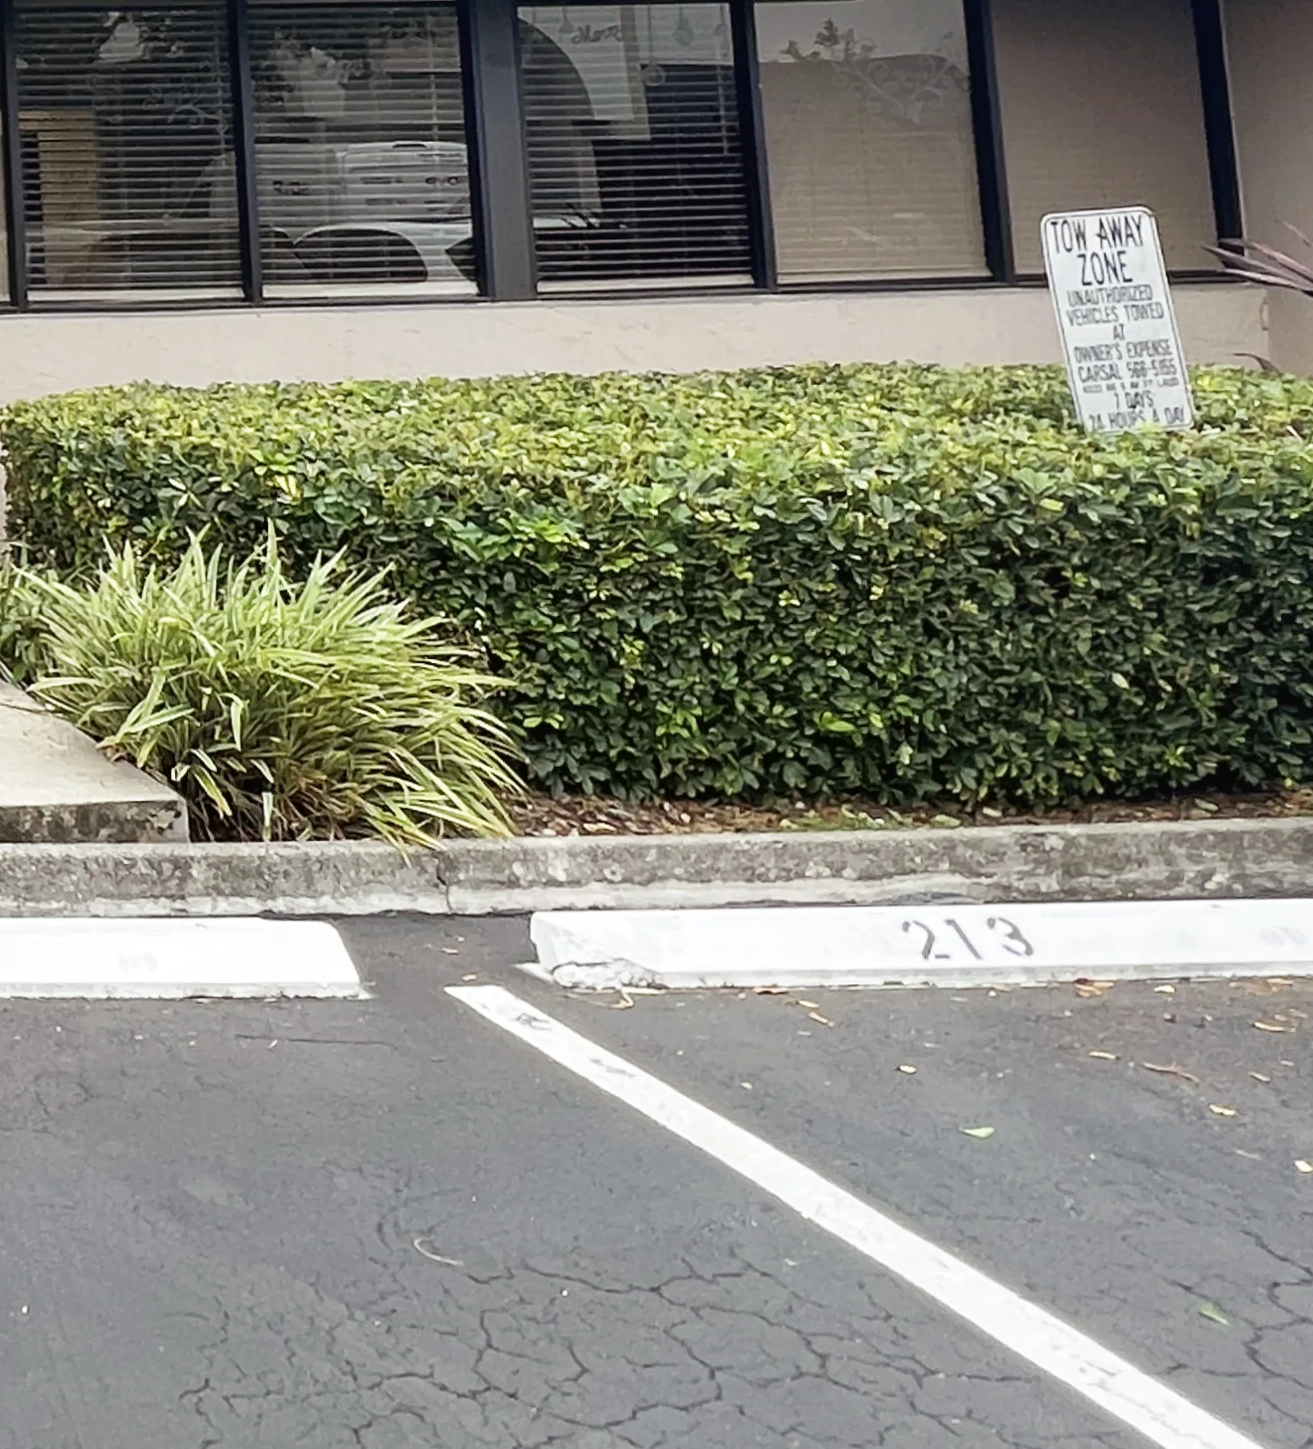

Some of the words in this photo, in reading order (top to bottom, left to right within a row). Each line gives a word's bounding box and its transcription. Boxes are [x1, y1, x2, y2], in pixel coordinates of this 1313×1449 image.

[1050, 220, 1087, 254] TOW
[1096, 214, 1145, 252] AWAY
[1077, 250, 1133, 286] ZONE
[1066, 284, 1153, 308] UNAUTHORIZED
[1066, 306, 1119, 327] VEHICLES
[1124, 302, 1165, 322] TOWED
[1112, 323, 1126, 341] AT
[1074, 343, 1123, 363] OWNER'S
[1126, 339, 1173, 359] EXPENSE
[902, 916, 1034, 960] 213
